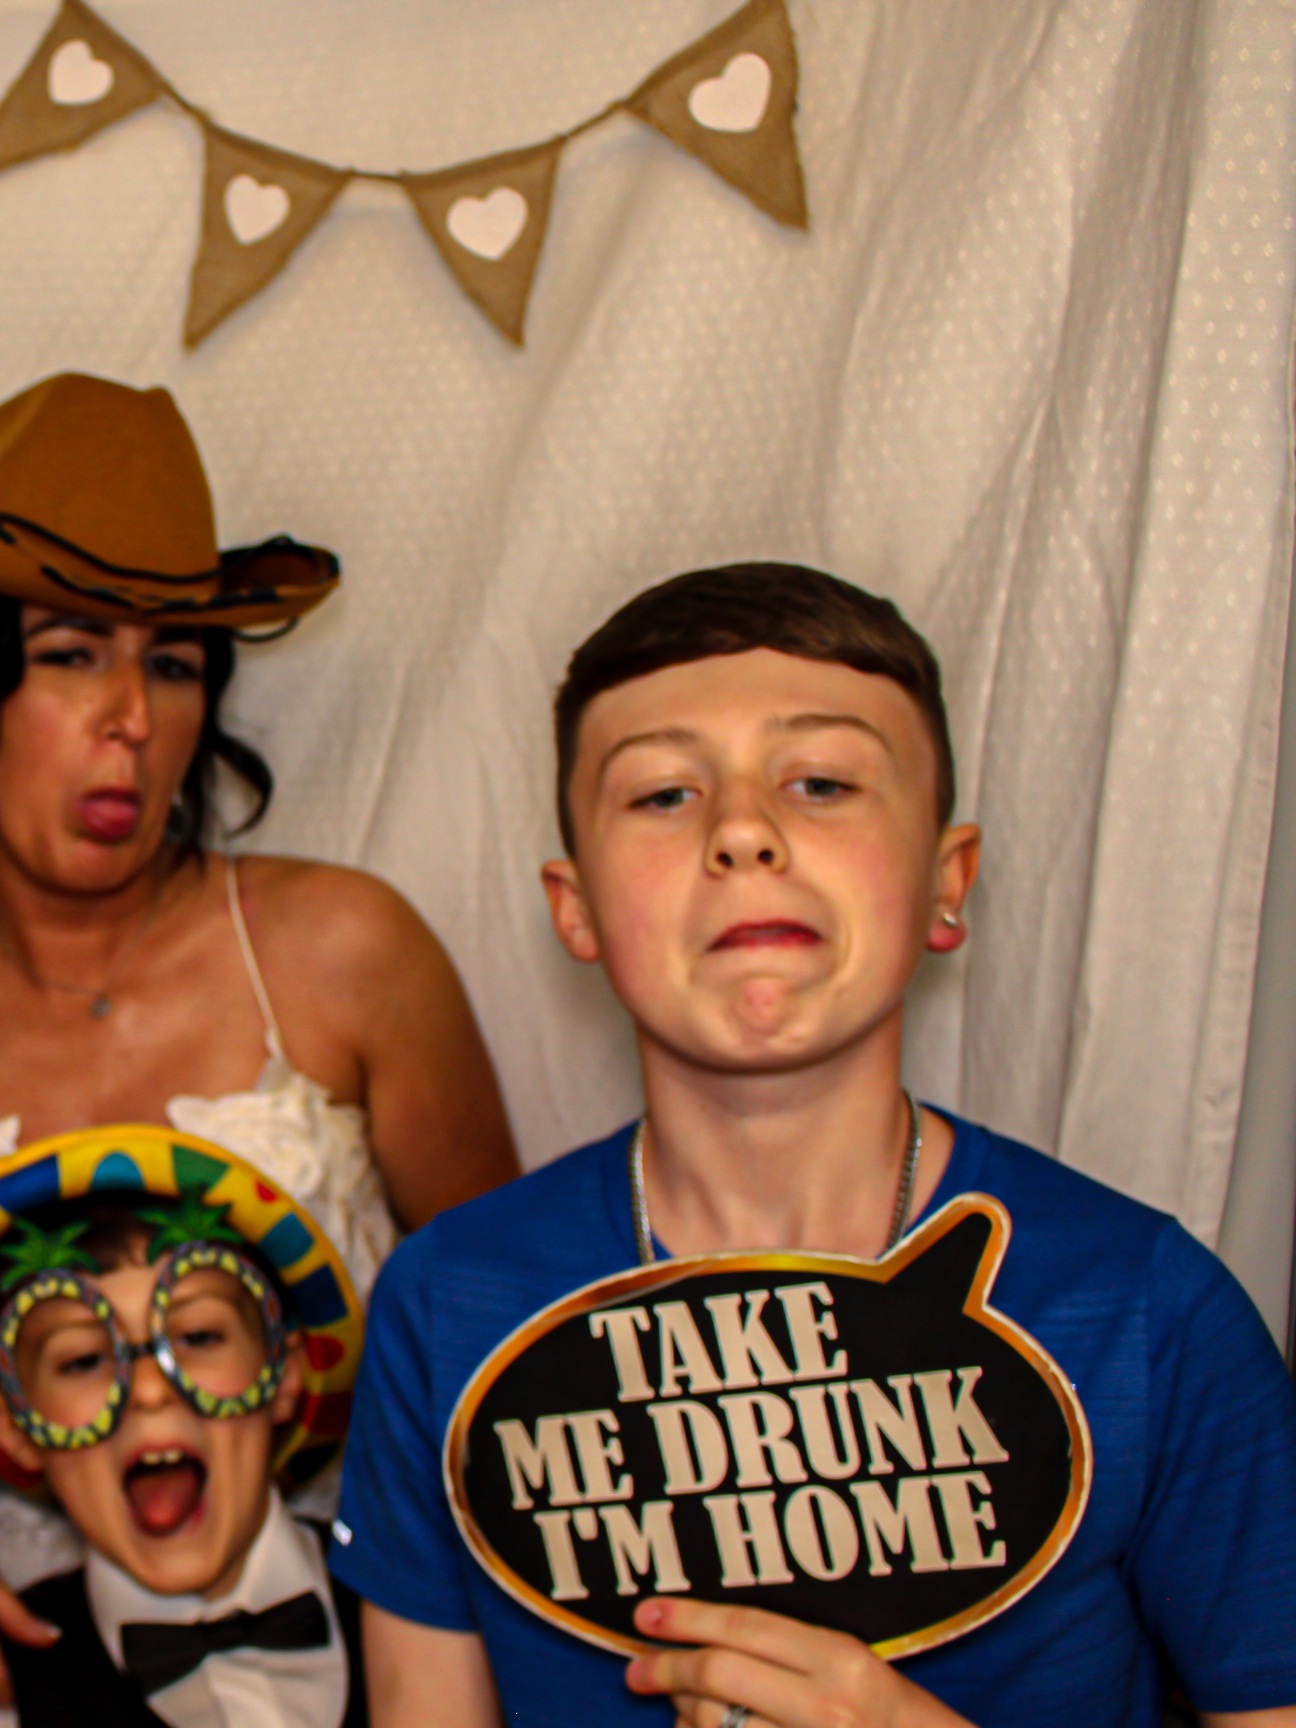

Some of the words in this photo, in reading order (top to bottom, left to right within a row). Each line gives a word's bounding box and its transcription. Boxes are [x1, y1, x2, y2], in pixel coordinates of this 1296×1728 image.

[589, 1281, 847, 1402] TAKE
[493, 1409, 633, 1509] ME
[647, 1366, 1008, 1494] DRUNK
[534, 1500, 691, 1600] I'M
[704, 1470, 1006, 1588] HOME
